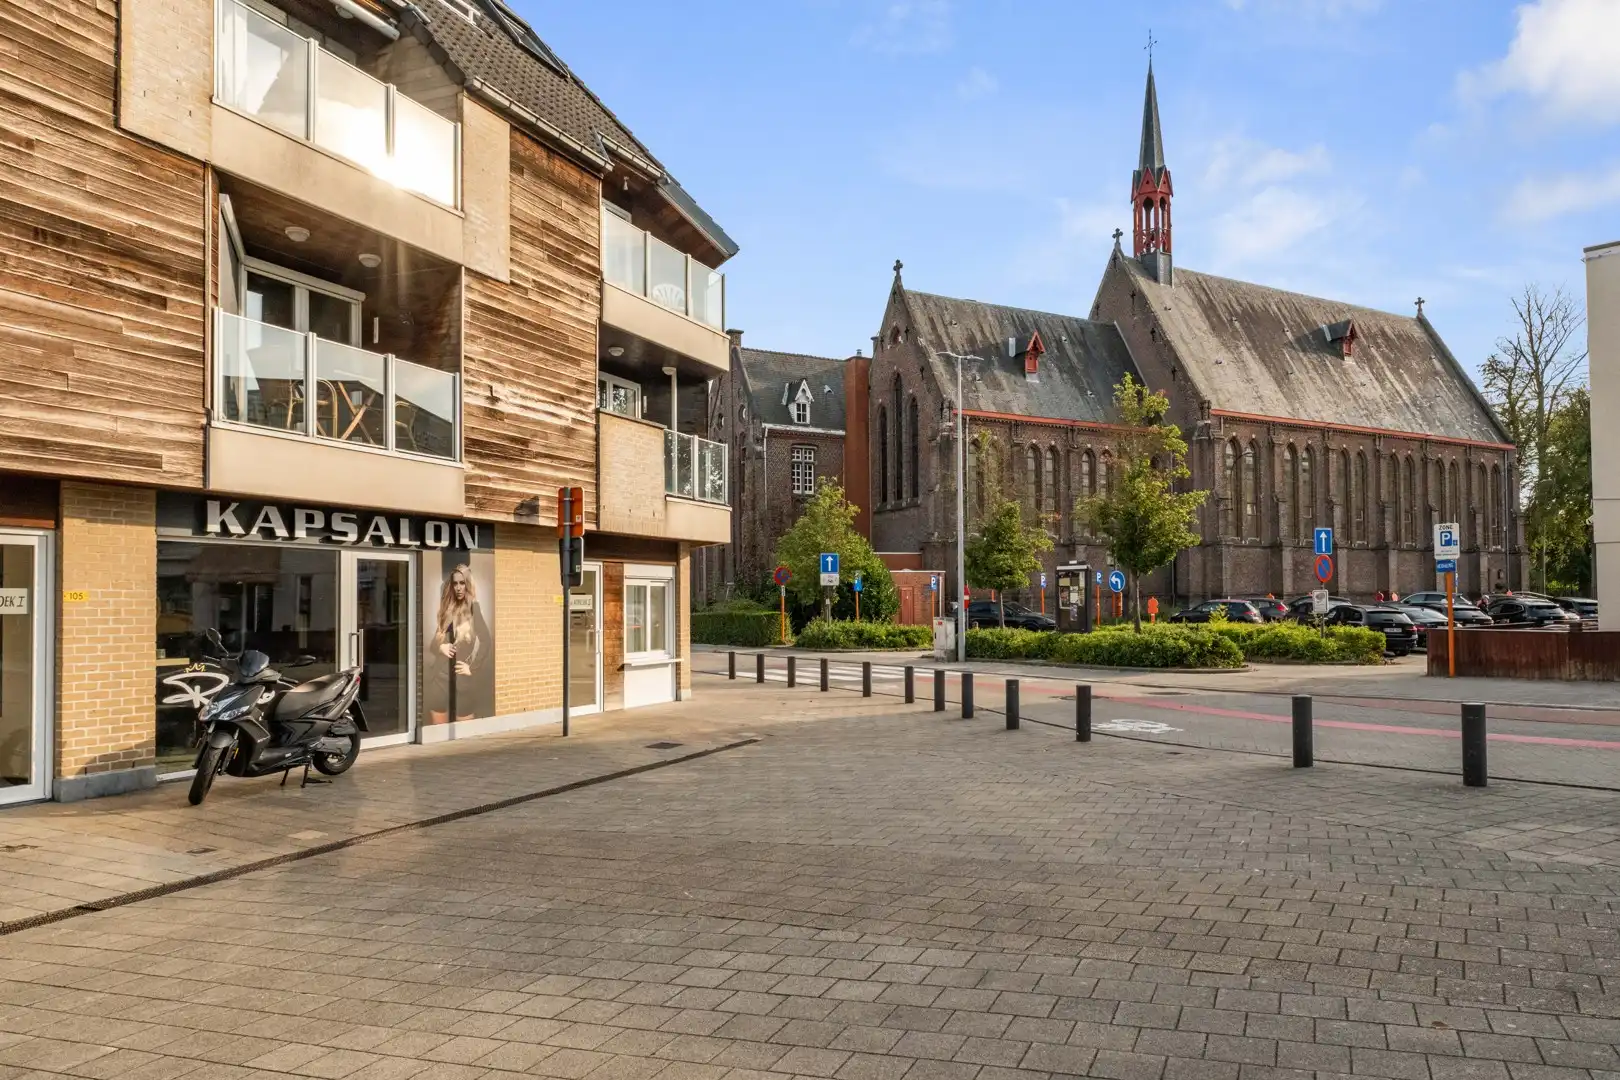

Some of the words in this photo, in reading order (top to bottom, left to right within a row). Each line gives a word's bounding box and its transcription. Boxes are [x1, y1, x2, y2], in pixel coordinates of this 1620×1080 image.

[206, 500, 478, 549] KAPSALON
[1441, 532, 1451, 545] P
[69, 592, 84, 600] 105
